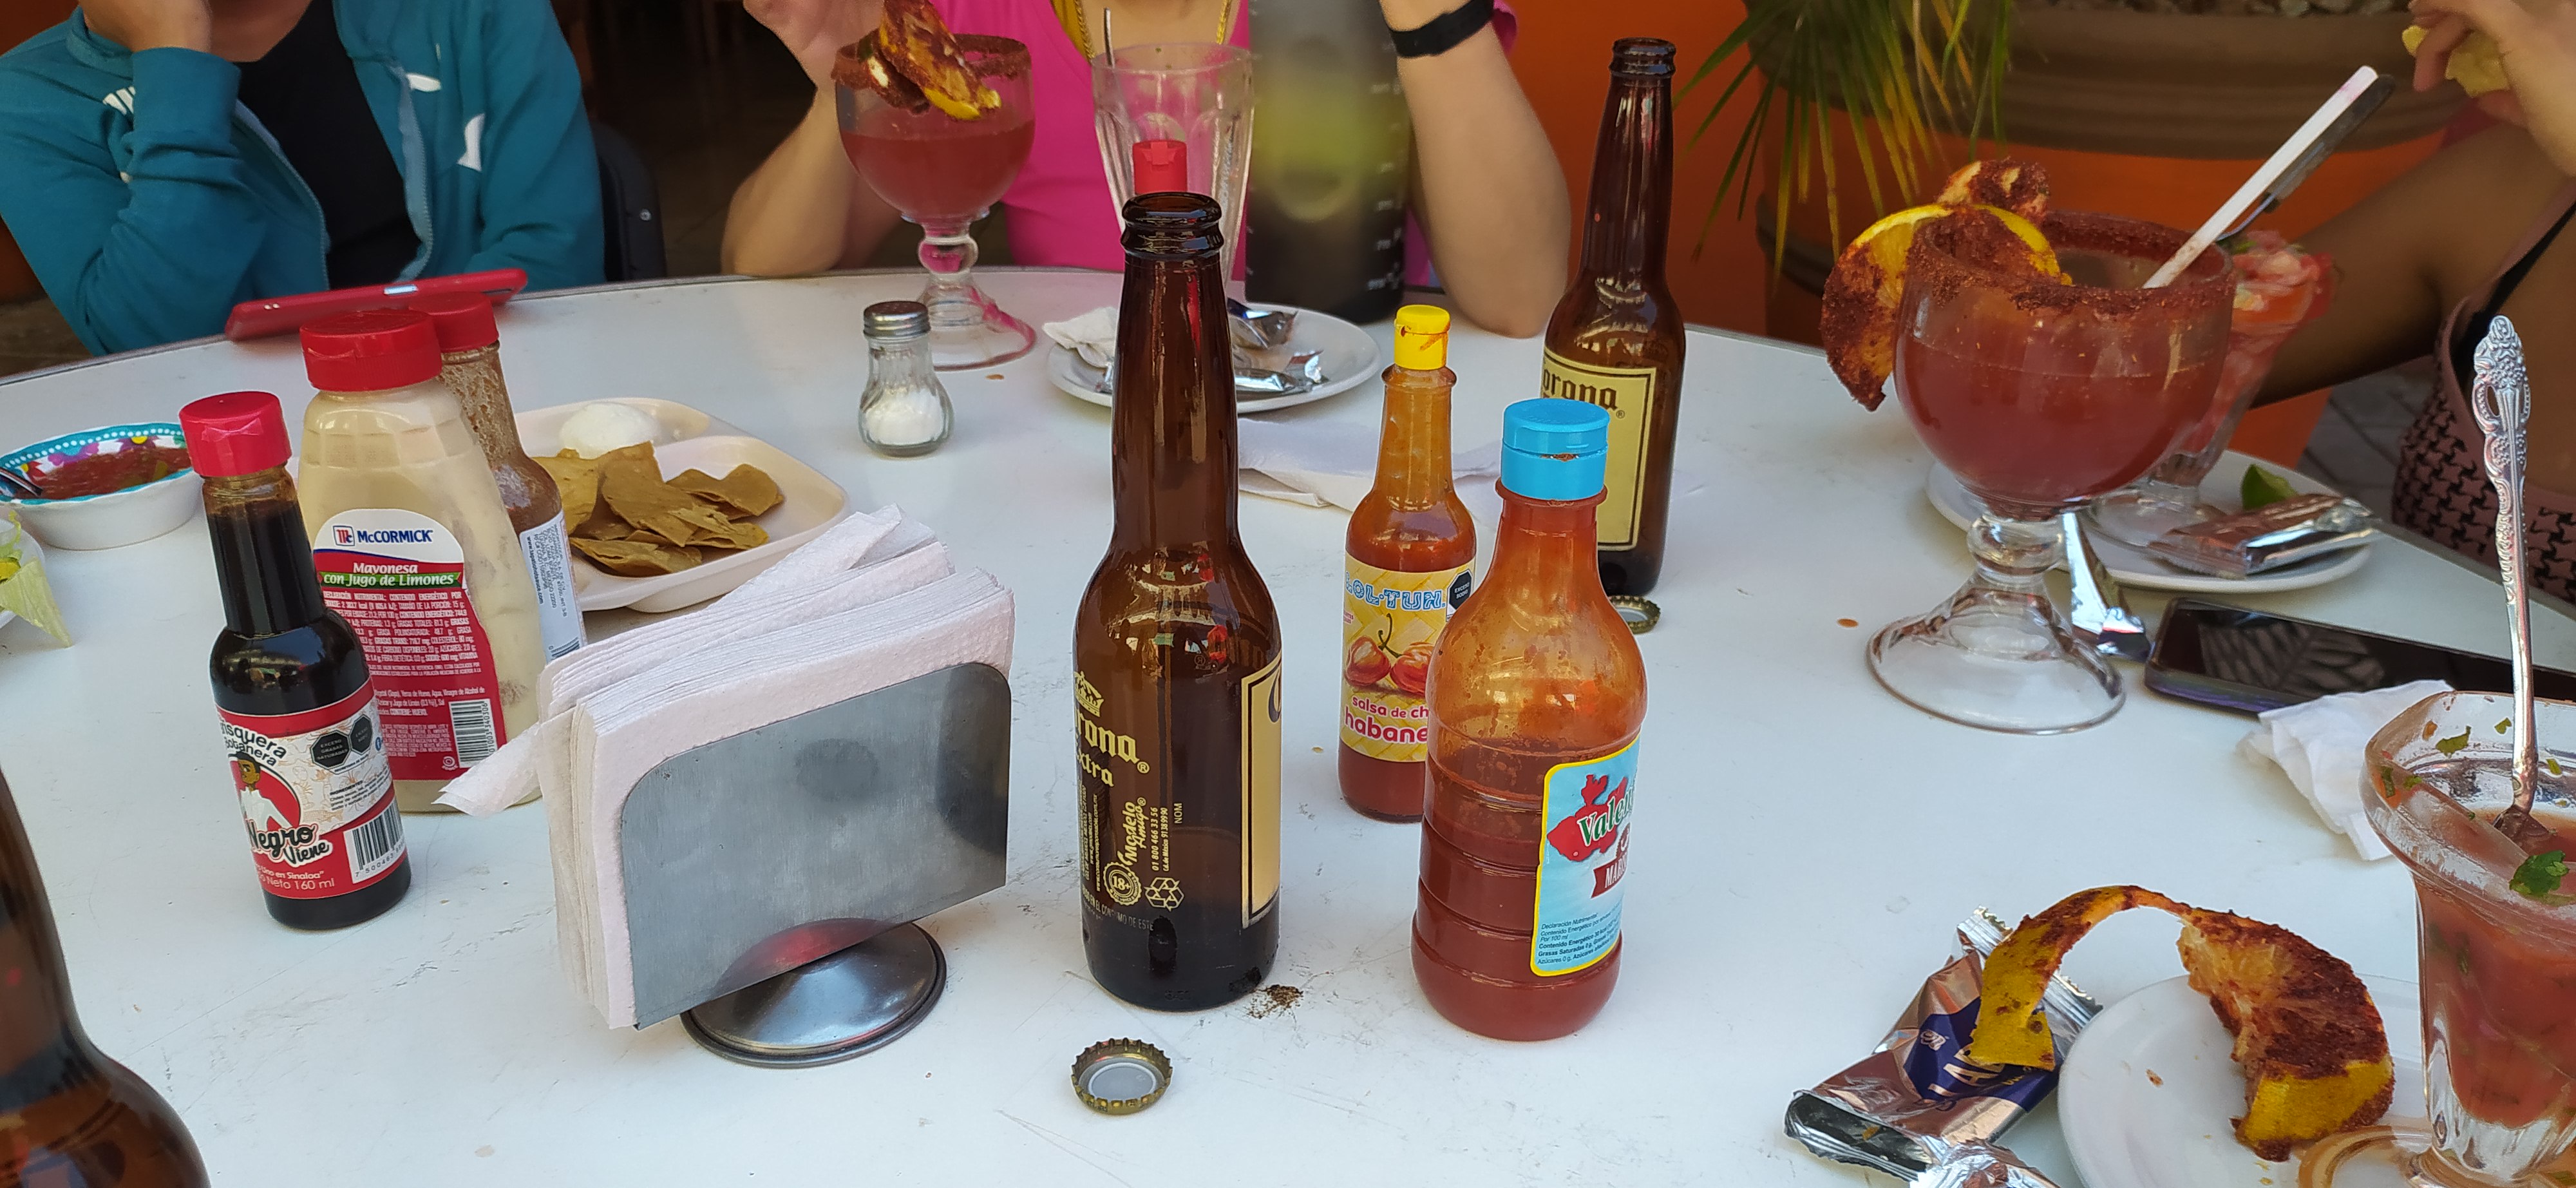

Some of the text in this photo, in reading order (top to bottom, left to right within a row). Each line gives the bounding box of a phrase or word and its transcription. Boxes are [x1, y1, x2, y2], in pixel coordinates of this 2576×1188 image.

[1543, 369, 1618, 411] orona
[357, 530, 433, 543] McCORMICK
[323, 573, 454, 587] con Jugo de Limones
[354, 562, 417, 576] Mayonesa
[1352, 696, 1428, 718] salsa de ch
[1345, 706, 1428, 743] habane
[486, 731, 496, 752] 01003
[1075, 708, 1140, 764] rona
[1077, 747, 1115, 787] xtra
[1150, 807, 1158, 818] 56
[1150, 818, 1159, 829] 33
[1173, 803, 1183, 825] NOM
[1578, 787, 1633, 845] Valen
[1119, 801, 1137, 864] Modelo
[1132, 805, 1150, 849] Amigo
[247, 821, 315, 857] Negro
[283, 841, 330, 864] Viene
[1151, 845, 1159, 860] 800
[266, 876, 291, 889] Neto
[294, 879, 316, 890] 160
[319, 877, 335, 888] ml
[1112, 876, 1132, 890] 18+
[1604, 859, 1626, 888] MARI
[1129, 917, 1136, 927] DE
[1138, 919, 1154, 931] ESTE
[1568, 935, 1594, 946] Energético
